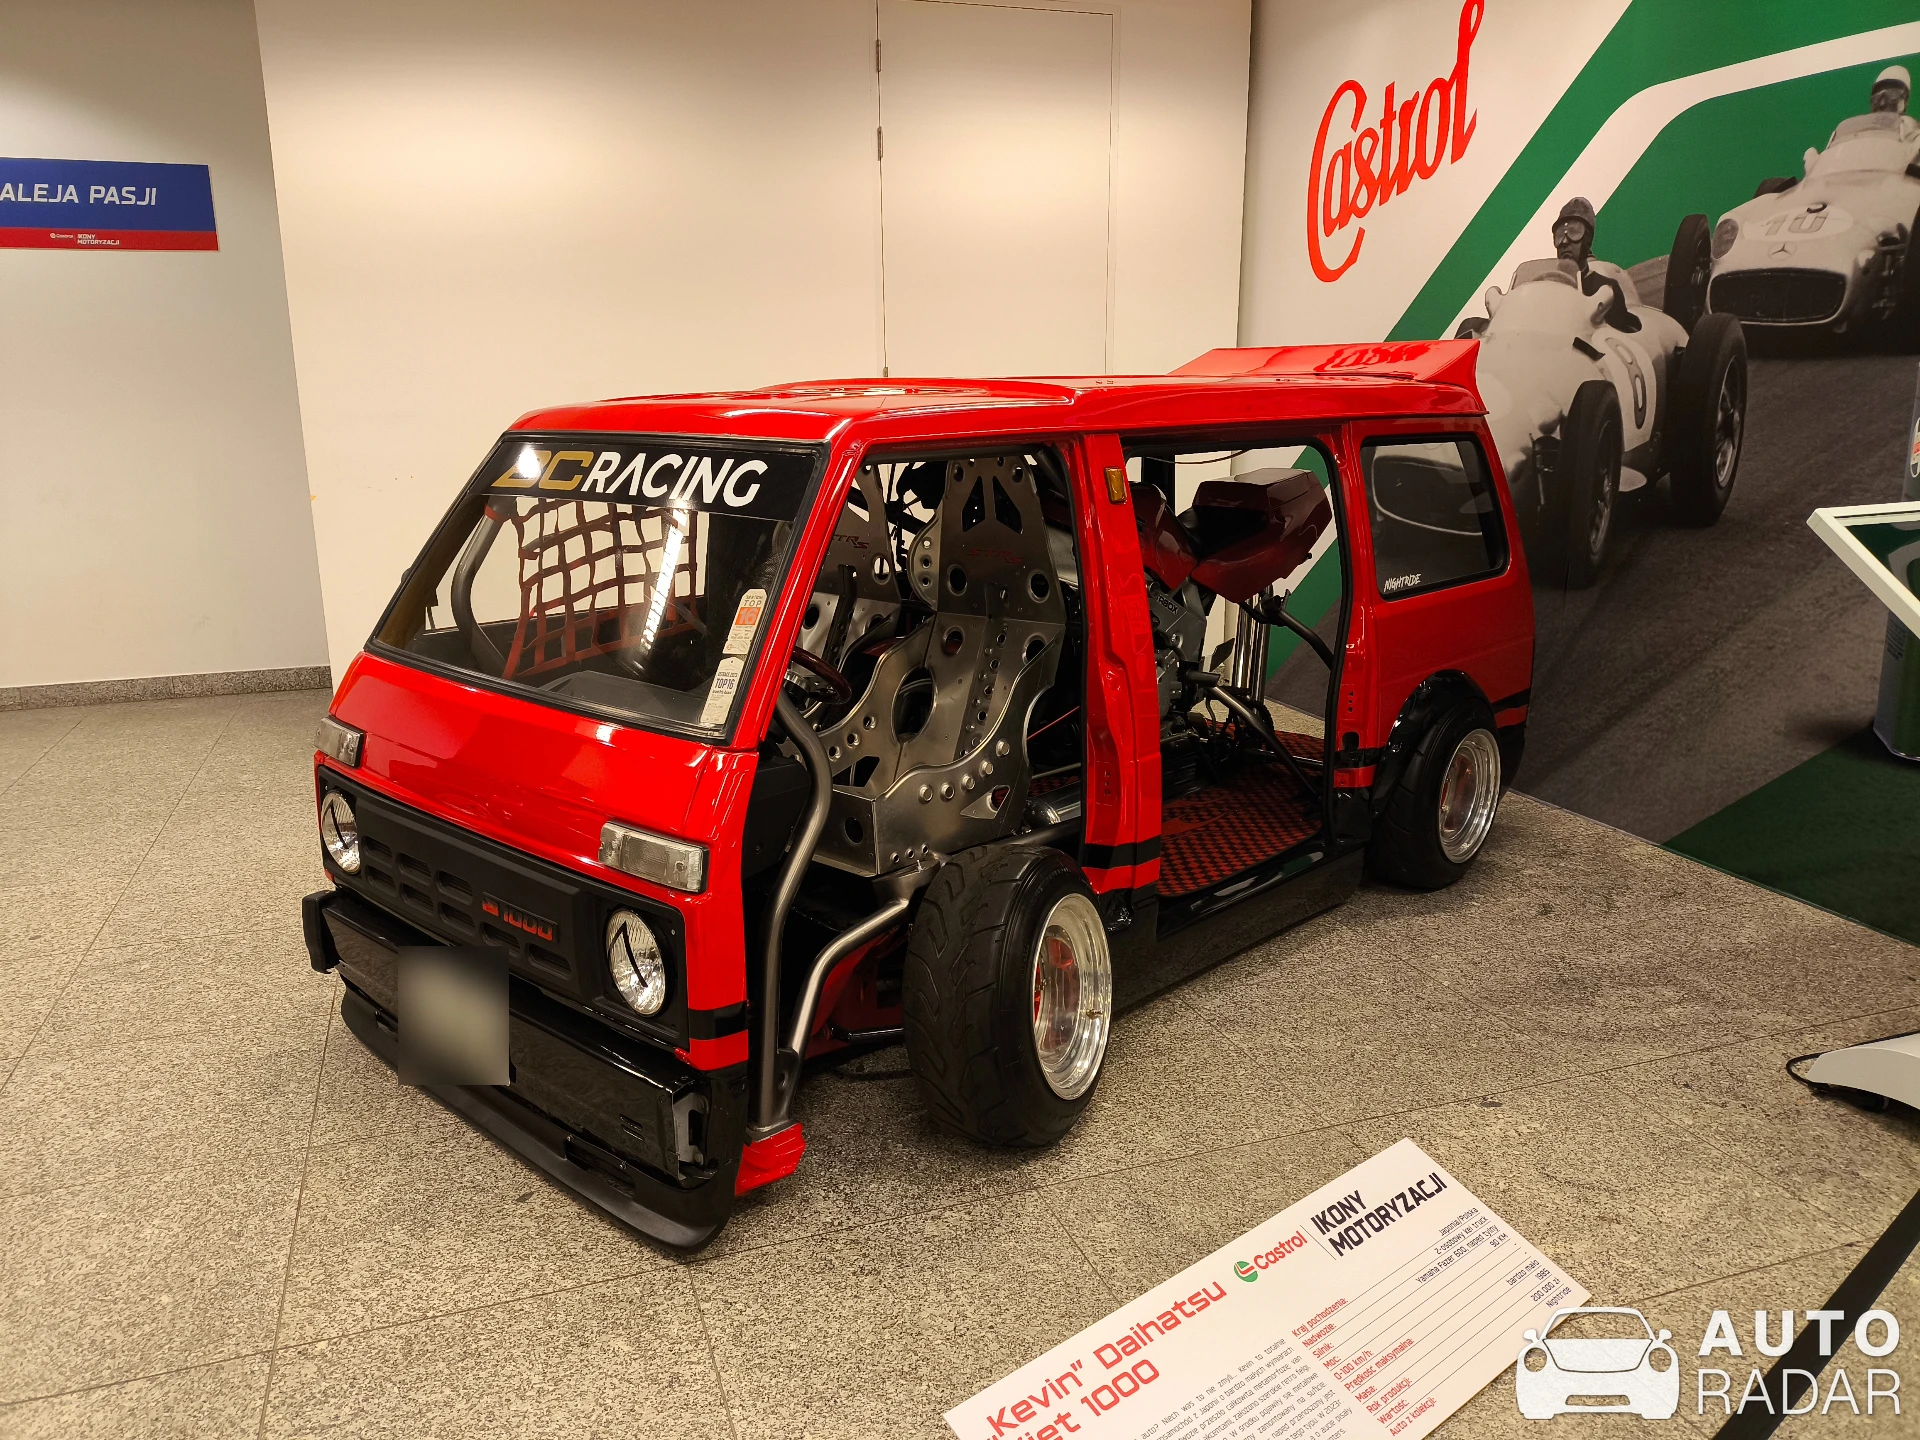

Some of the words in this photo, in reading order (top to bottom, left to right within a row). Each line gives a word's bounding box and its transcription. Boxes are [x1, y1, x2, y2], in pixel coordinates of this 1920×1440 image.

[1307, 0, 1484, 282] Castrol
[0, 182, 79, 204] ALEJA
[89, 186, 157, 206] PASJI
[1383, 573, 1422, 593] NIGHTRIDE
[743, 599, 762, 608] TOP
[1310, 1189, 1367, 1236] IKONY
[1328, 1172, 1448, 1257] MOTORYZACJI
[1253, 1230, 1308, 1270] Castrol
[1489, 1238, 1500, 1248] 90
[1497, 1232, 1509, 1242] KM
[1415, 1266, 1440, 1284] Yamaha
[1437, 1254, 1455, 1269] Fazer
[1506, 1269, 1527, 1286] bardzo
[1545, 1286, 1572, 1308] Nightride
[1093, 1281, 1227, 1370] Daihatsu
[1291, 1324, 1310, 1337] Kraj
[1307, 1298, 1348, 1328] pochodzenia:
[1301, 1323, 1337, 1348] Nadwozie:
[1312, 1341, 1335, 1359] Silnik:
[1322, 1355, 1342, 1370] Moc:
[1375, 1337, 1415, 1369] maksymalna:
[1333, 1362, 1355, 1380] 0-100
[1354, 1350, 1375, 1367] km/h:
[1081, 1359, 1160, 1417] 1000
[1161, 1411, 1180, 1425] Niech
[1181, 1401, 1195, 1412] was
[1196, 1394, 1206, 1403] to
[1255, 1353, 1264, 1361] to
[1224, 1380, 1246, 1397] bardzo
[1296, 1396, 1306, 1405] na
[1323, 1389, 1336, 1402] jest
[1354, 1385, 1378, 1403] Masa:
[1366, 1400, 1382, 1414] Rok
[1380, 1377, 1413, 1404] produkcji:
[1389, 1420, 1408, 1437] Auto
[1406, 1415, 1413, 1424] z
[1411, 1396, 1437, 1420] kolekcji:
